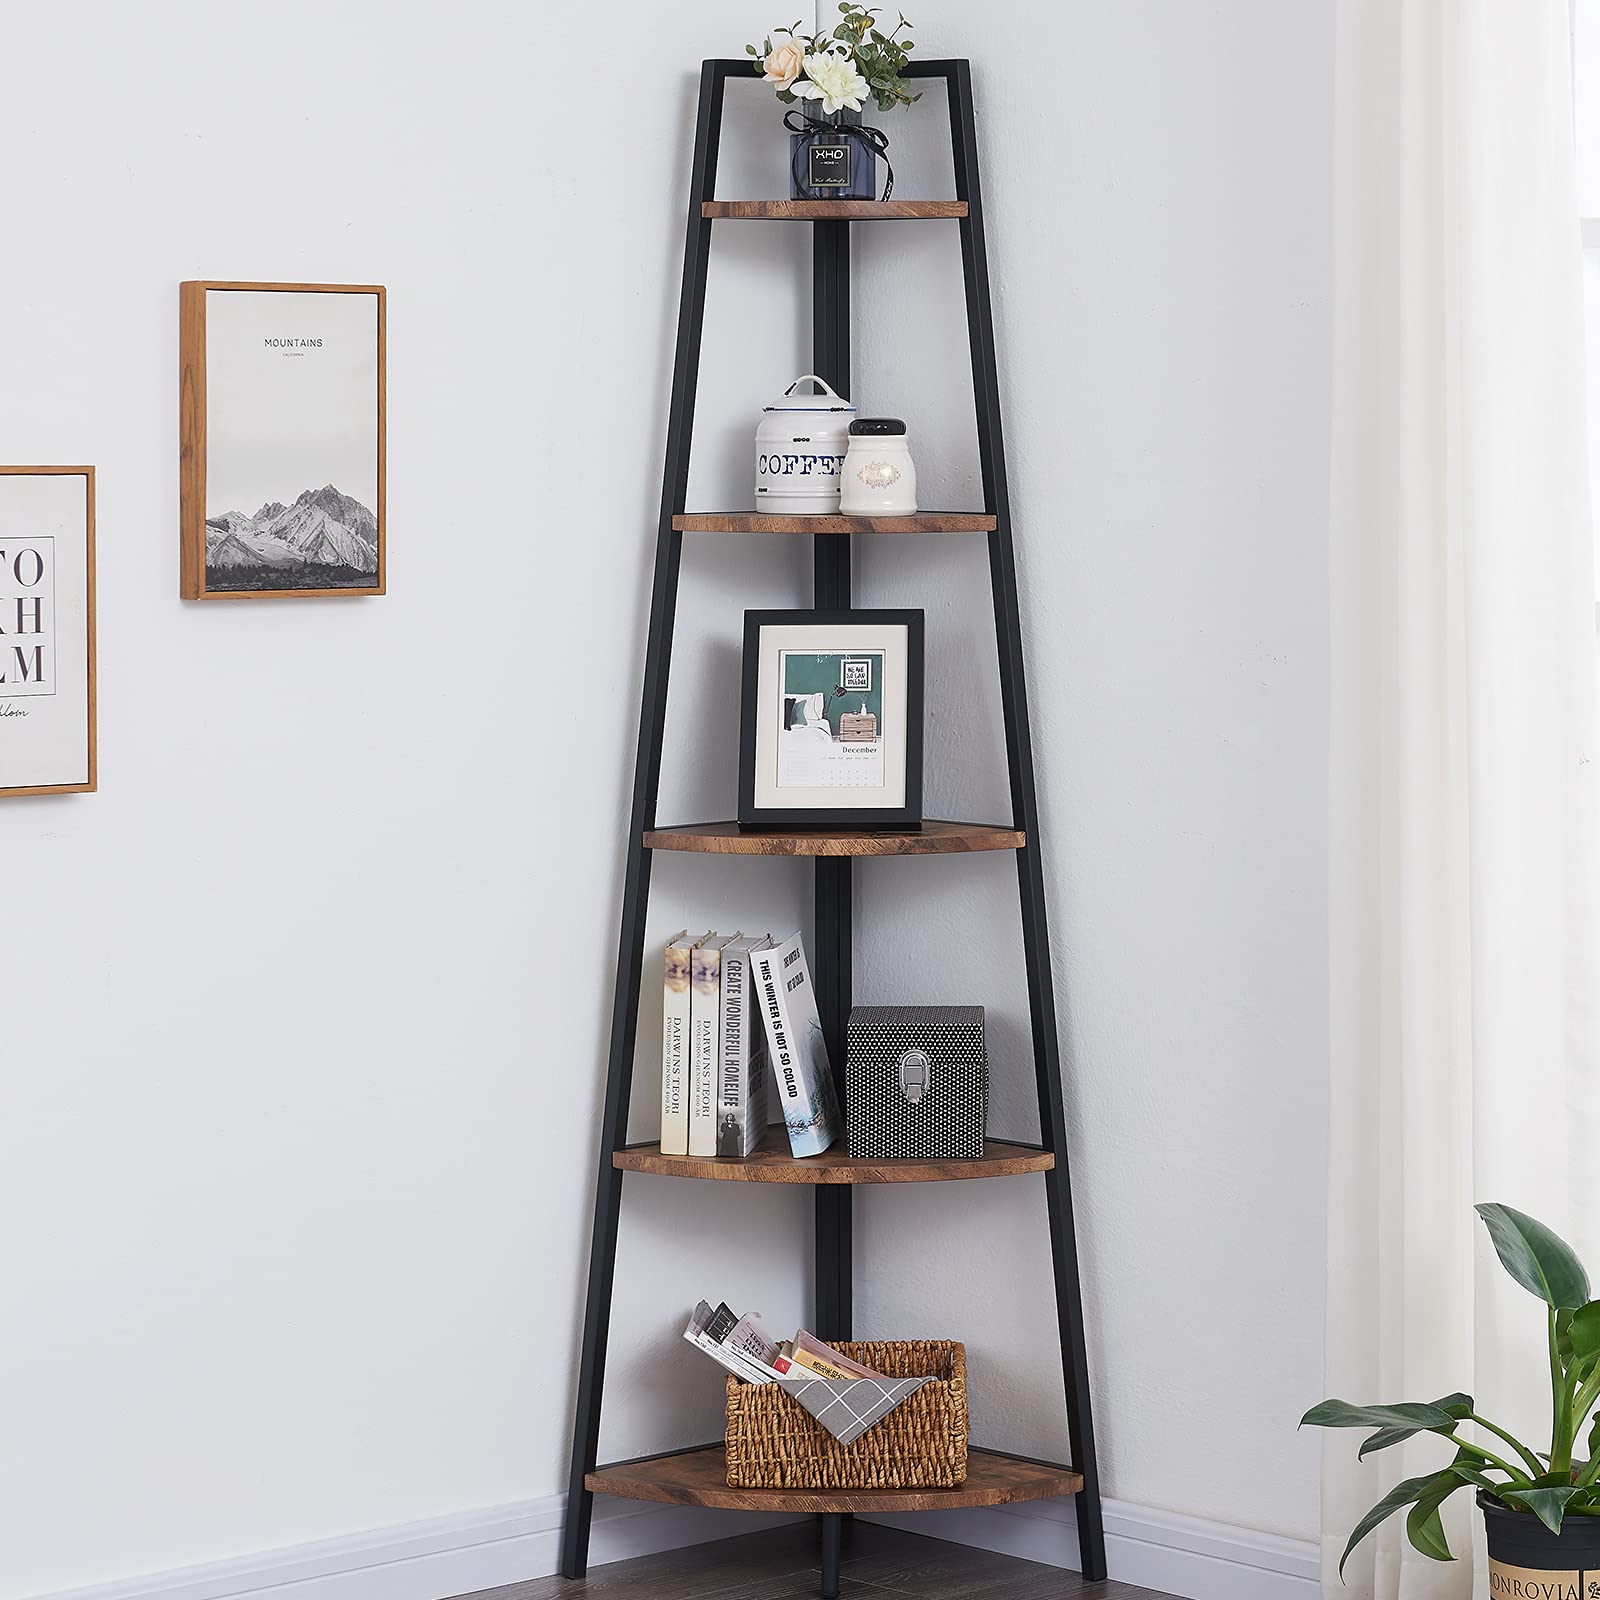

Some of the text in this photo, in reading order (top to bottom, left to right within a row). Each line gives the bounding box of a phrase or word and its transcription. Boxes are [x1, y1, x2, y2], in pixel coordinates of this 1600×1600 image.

[264, 338, 323, 348] MOUNTAINS
[842, 746, 877, 754] December
[672, 1017, 682, 1114] DARWINS TEORI
[702, 1020, 711, 1118] DARWINS TEORI
[724, 960, 742, 1107] CREATE WONDERFUL HOMELIFE
[759, 960, 798, 1098] THIS WINTER IS NOT SO COLOD
[1490, 1572, 1579, 1600] ONROVIA
